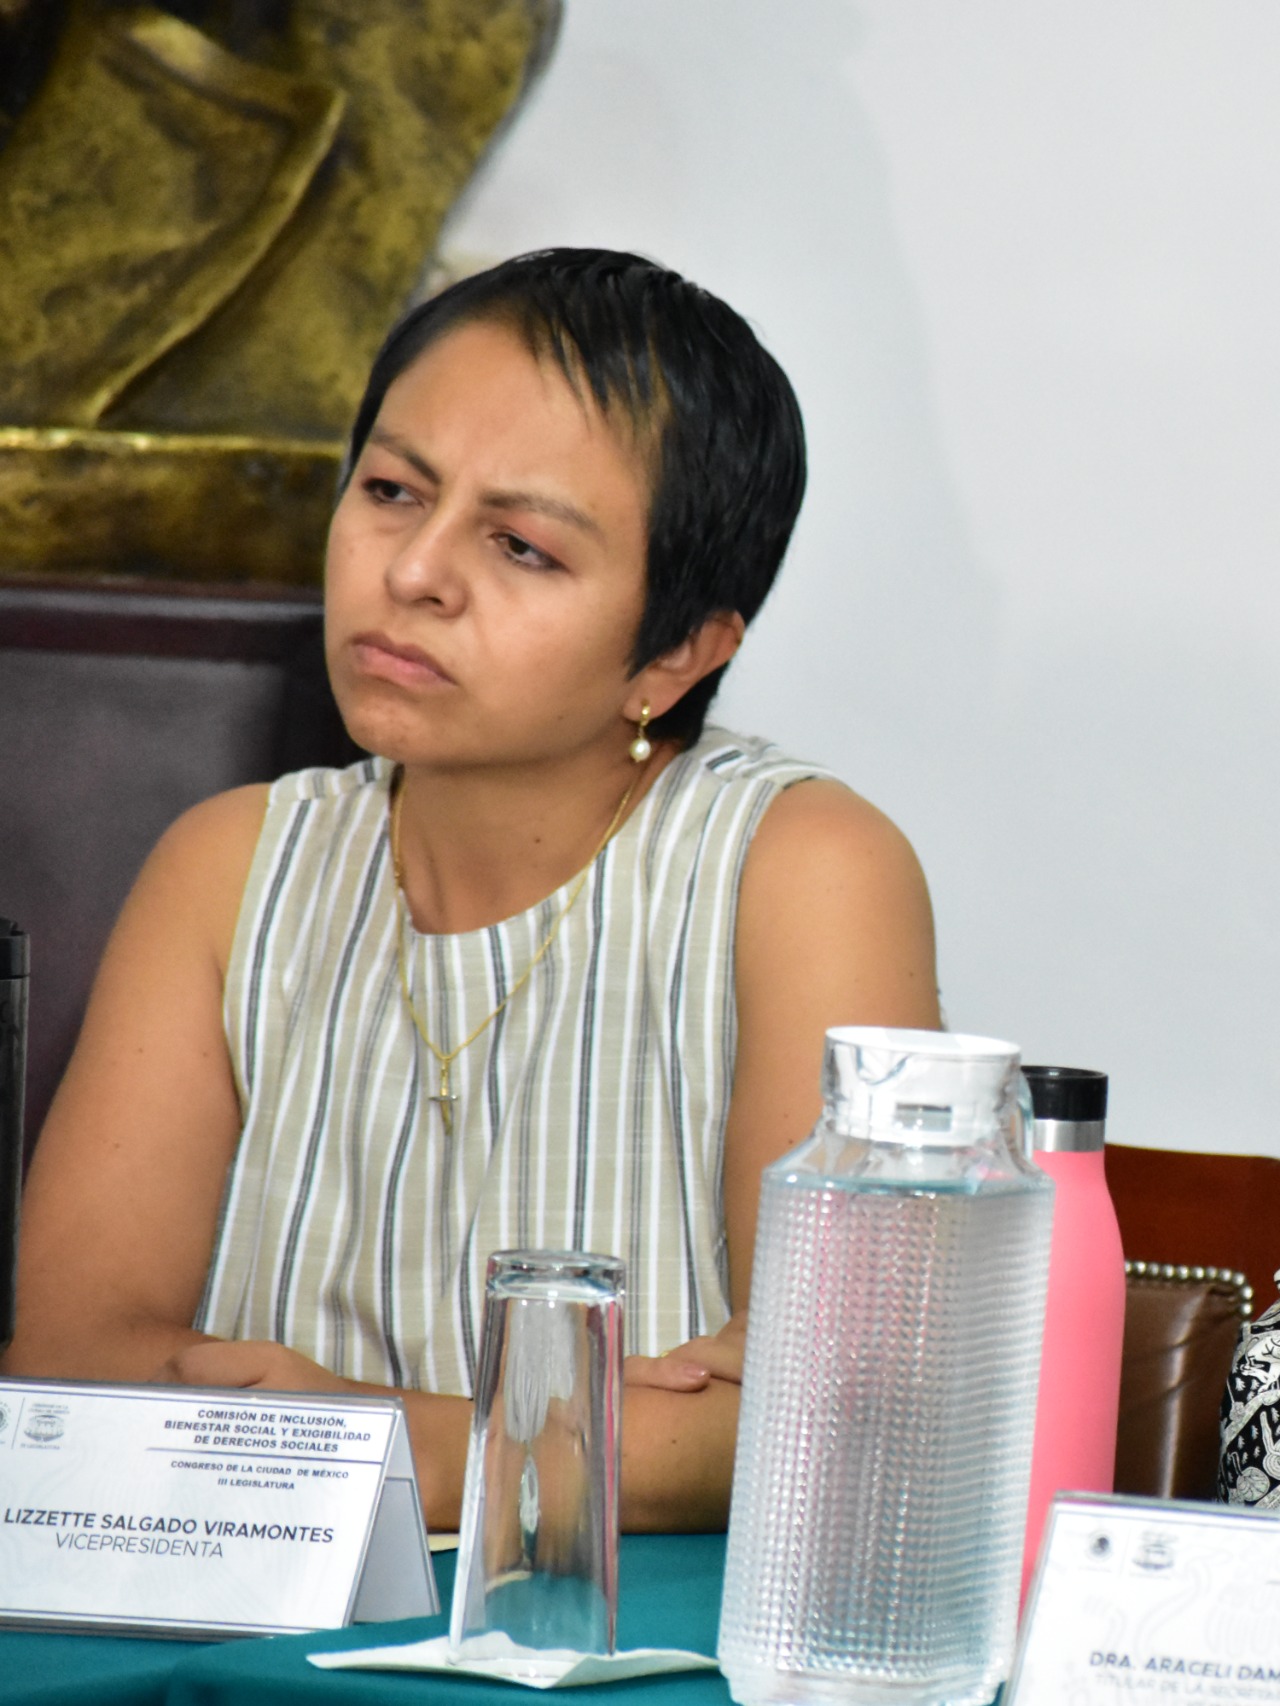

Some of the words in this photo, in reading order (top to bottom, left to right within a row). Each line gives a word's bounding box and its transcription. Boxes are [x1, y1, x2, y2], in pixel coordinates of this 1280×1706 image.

[197, 1409, 257, 1421] COMISIÓN
[260, 1412, 276, 1423] DE
[164, 1420, 230, 1433] BIENESTAR
[234, 1424, 276, 1436] SOCIAL
[281, 1427, 288, 1437] Y
[292, 1428, 371, 1442] EXIGIBILIDAD
[194, 1435, 210, 1445] DE
[213, 1436, 277, 1449] DERECHOS
[280, 1440, 339, 1453] SOCIALES
[171, 1460, 223, 1472] CONGRESO
[226, 1463, 238, 1473] DE
[241, 1464, 253, 1474] LA
[256, 1465, 291, 1476] CIUDAD
[297, 1468, 309, 1478] DE
[312, 1467, 349, 1479] MÉXICO
[217, 1477, 228, 1487] III
[230, 1478, 295, 1490] LEGISLATURA
[3, 1507, 96, 1529] LIZZETTE
[100, 1513, 197, 1534] SALGADO
[203, 1520, 334, 1544] VIRAMONTES
[55, 1532, 223, 1558] VICEPRESIDENTA
[1145, 1656, 1232, 1679] ARACELI
